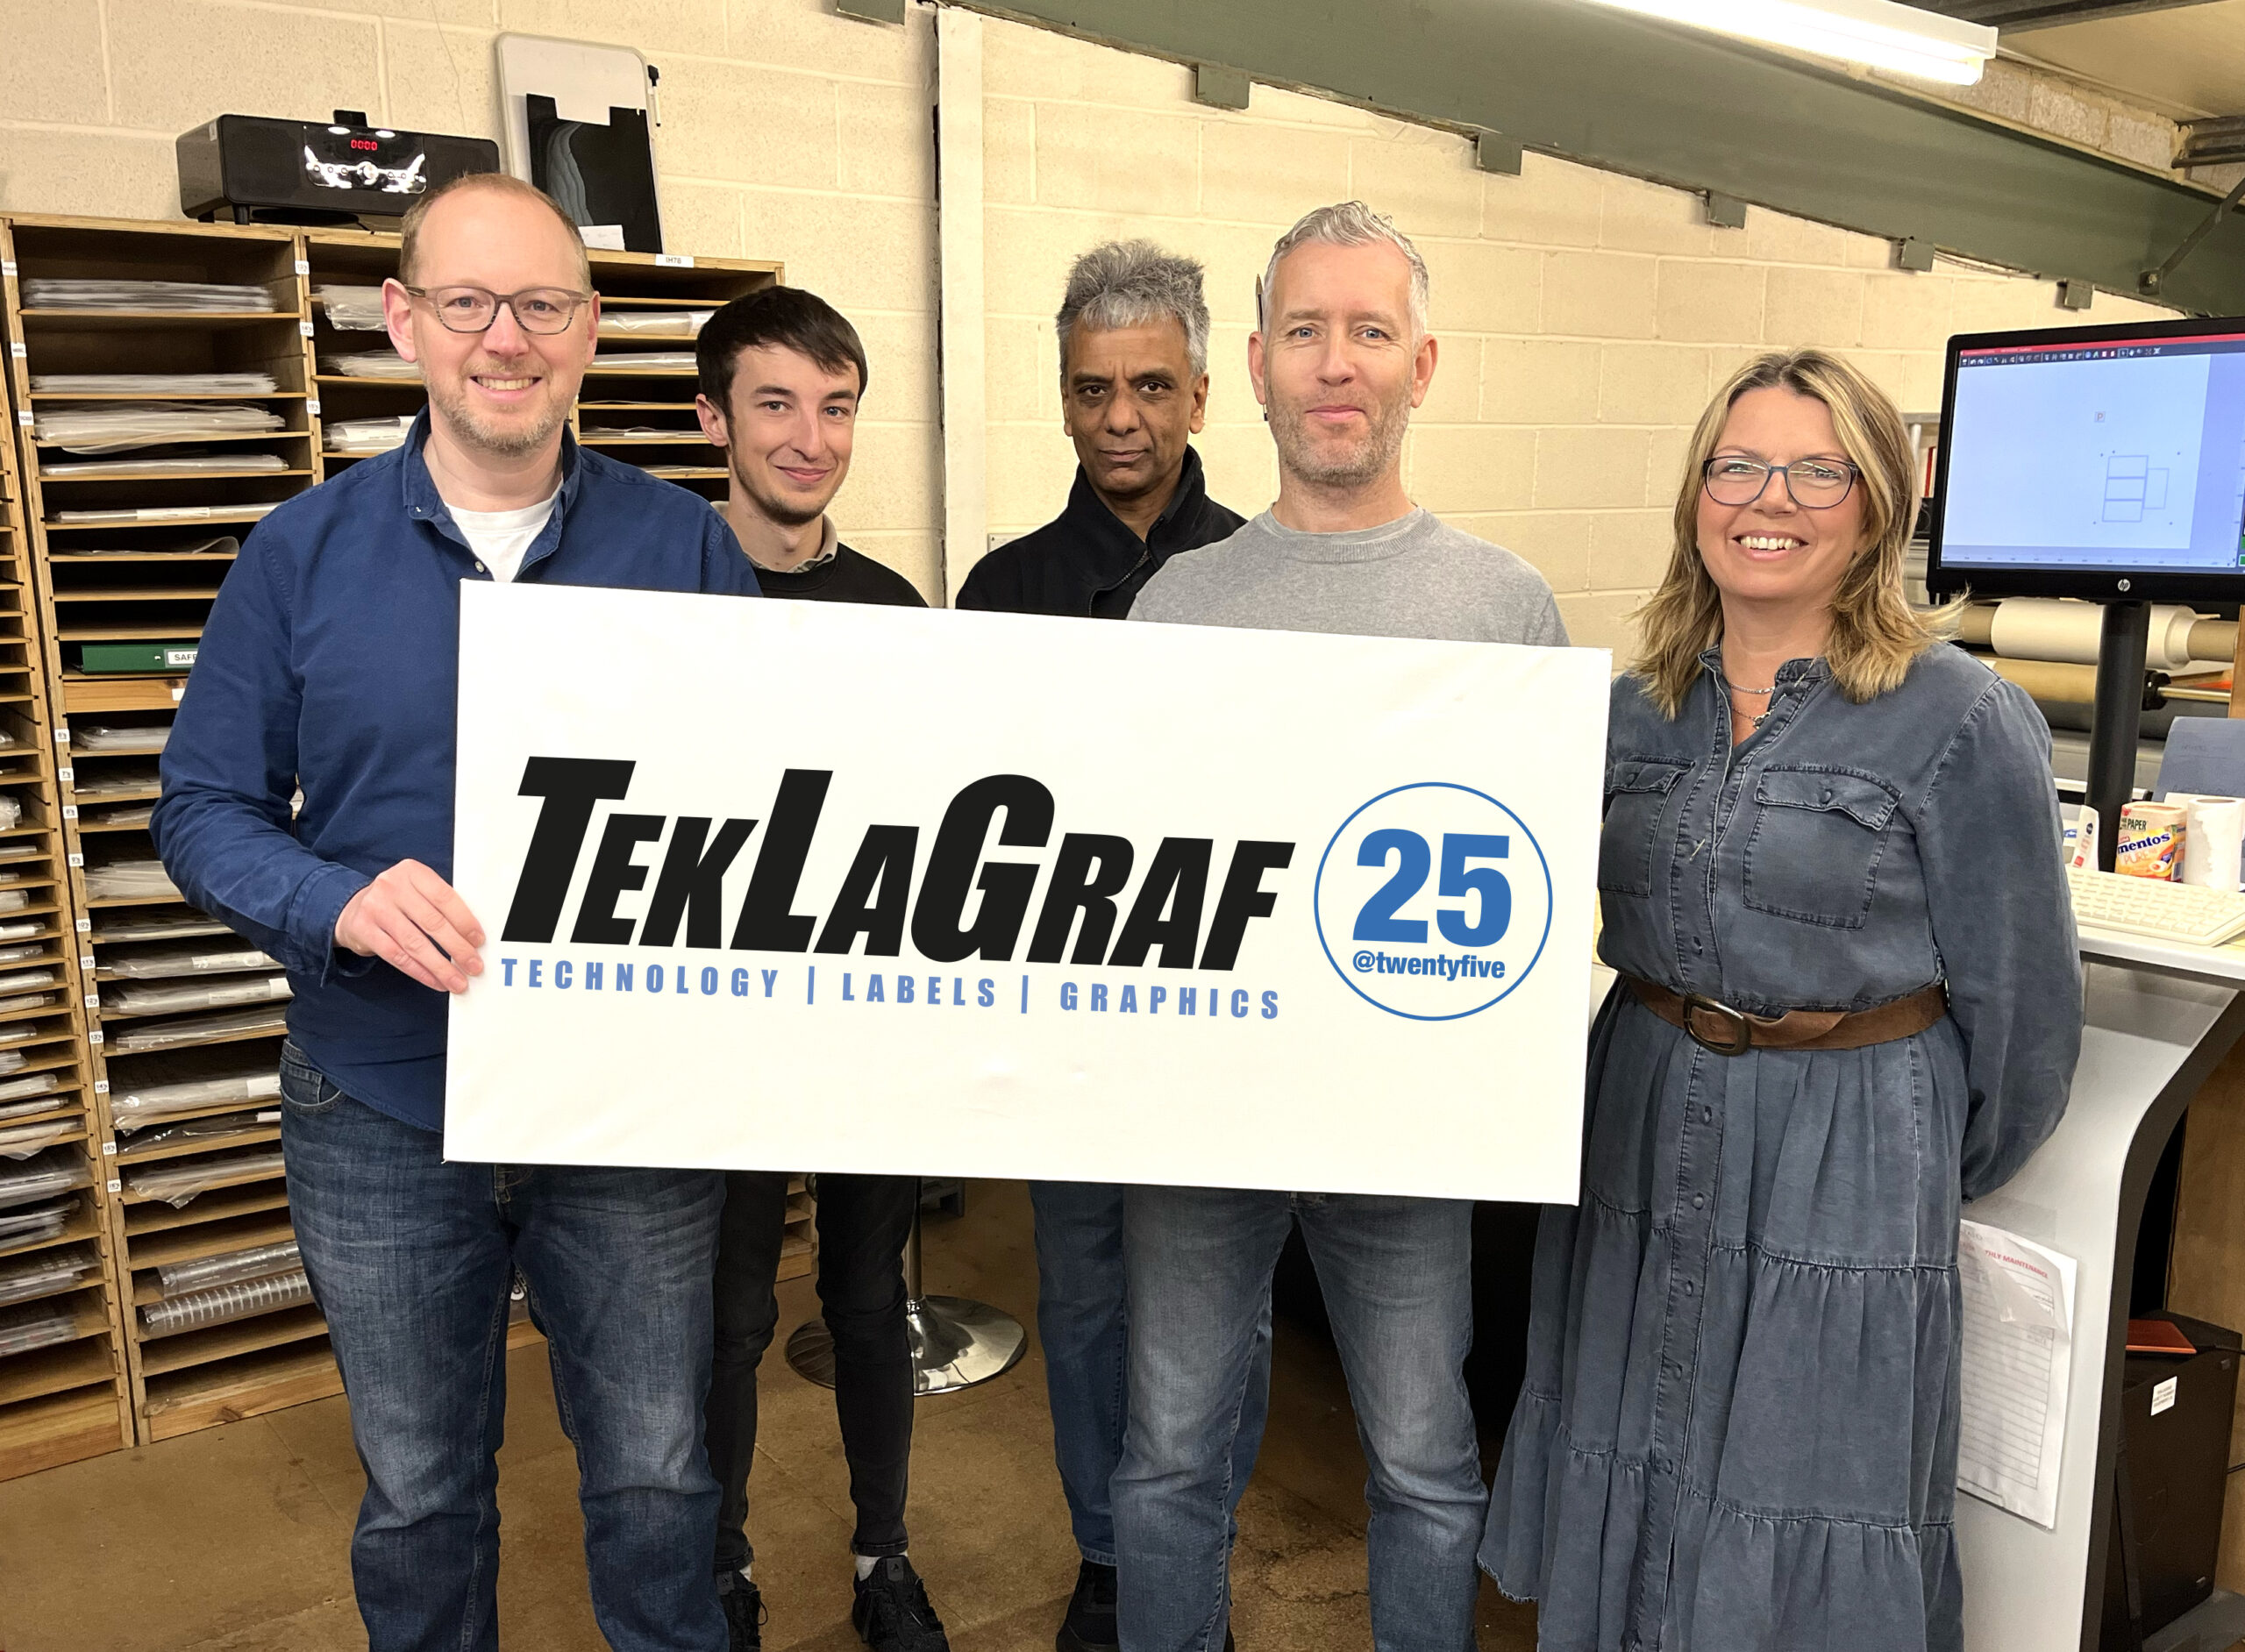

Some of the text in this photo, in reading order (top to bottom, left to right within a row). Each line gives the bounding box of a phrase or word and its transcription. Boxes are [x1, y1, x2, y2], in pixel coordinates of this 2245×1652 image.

[2119, 579, 2129, 591] hp
[2127, 818, 2147, 830] PAPER
[2118, 833, 2170, 855] mentos
[1353, 829, 1511, 947] 25
[1353, 951, 1505, 981] @twentyfive
[502, 958, 777, 997] TECHNOLOGY
[843, 973, 994, 1008] LABELS
[1061, 982, 1277, 1019] GRAPHICS
[2003, 1255, 2048, 1278] MAINTENANCE
